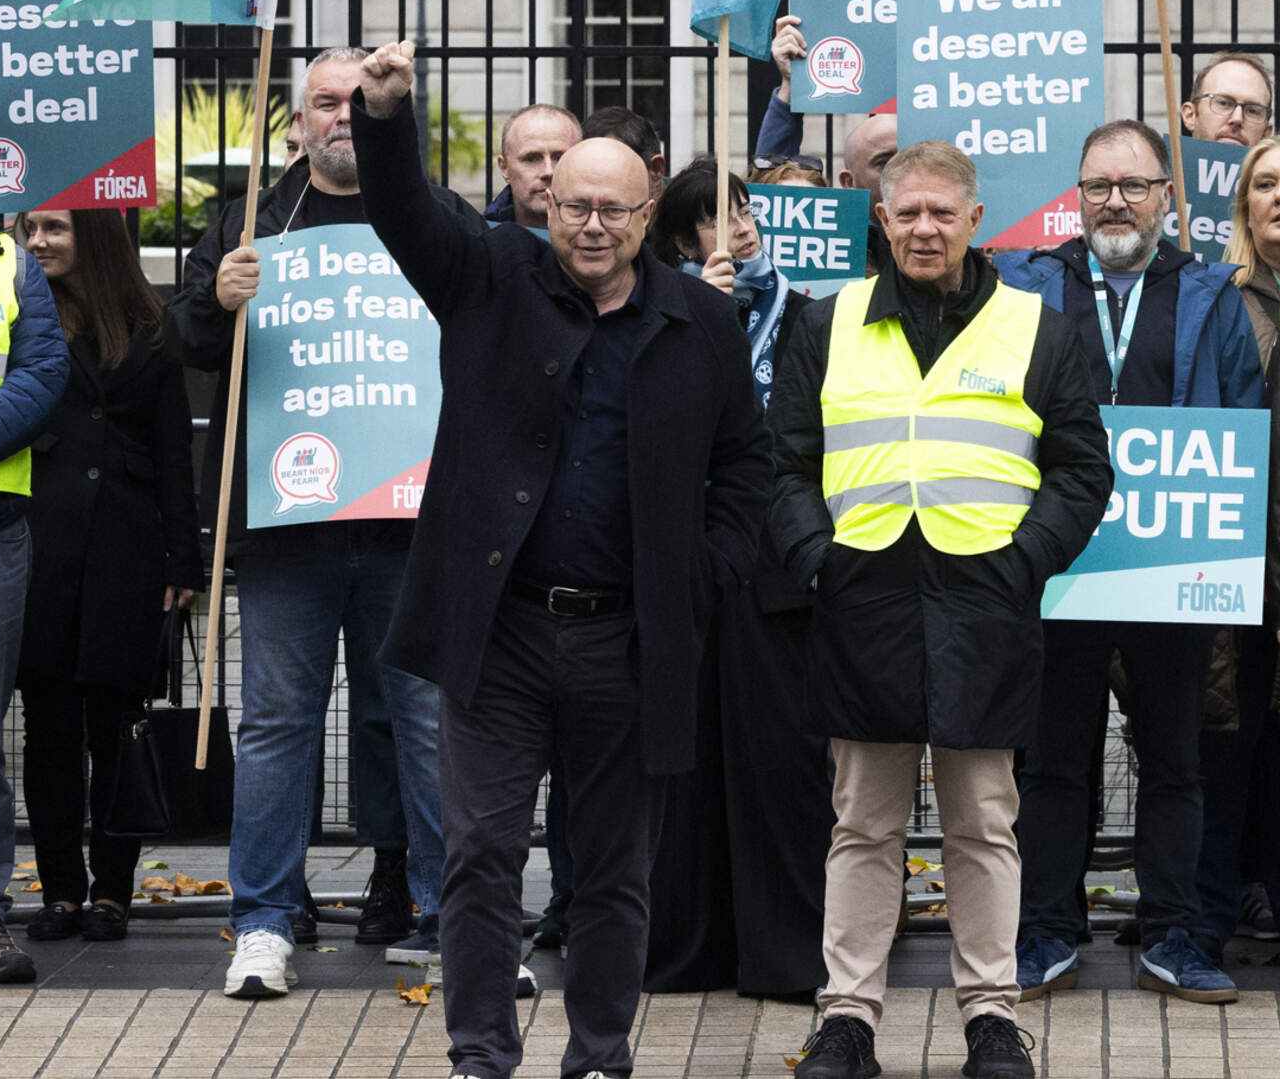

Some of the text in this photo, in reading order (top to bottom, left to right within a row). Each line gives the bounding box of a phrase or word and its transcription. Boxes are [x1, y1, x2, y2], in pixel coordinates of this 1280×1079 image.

[2, 42, 139, 77] better
[912, 25, 1087, 62] deserve
[818, 61, 856, 69] BETTER
[818, 70, 844, 78] DEAL
[8, 86, 97, 124] deal
[912, 72, 1089, 109] a better
[955, 117, 1047, 155] deal
[94, 169, 148, 200] FÓRSA
[749, 194, 838, 230] RIKE
[272, 247, 310, 282] Tá
[257, 292, 335, 329] níos
[289, 329, 409, 367] tuillte
[283, 374, 417, 417] againn
[958, 367, 1006, 396] FÓRSA
[1177, 572, 1245, 612] FÓRSA
